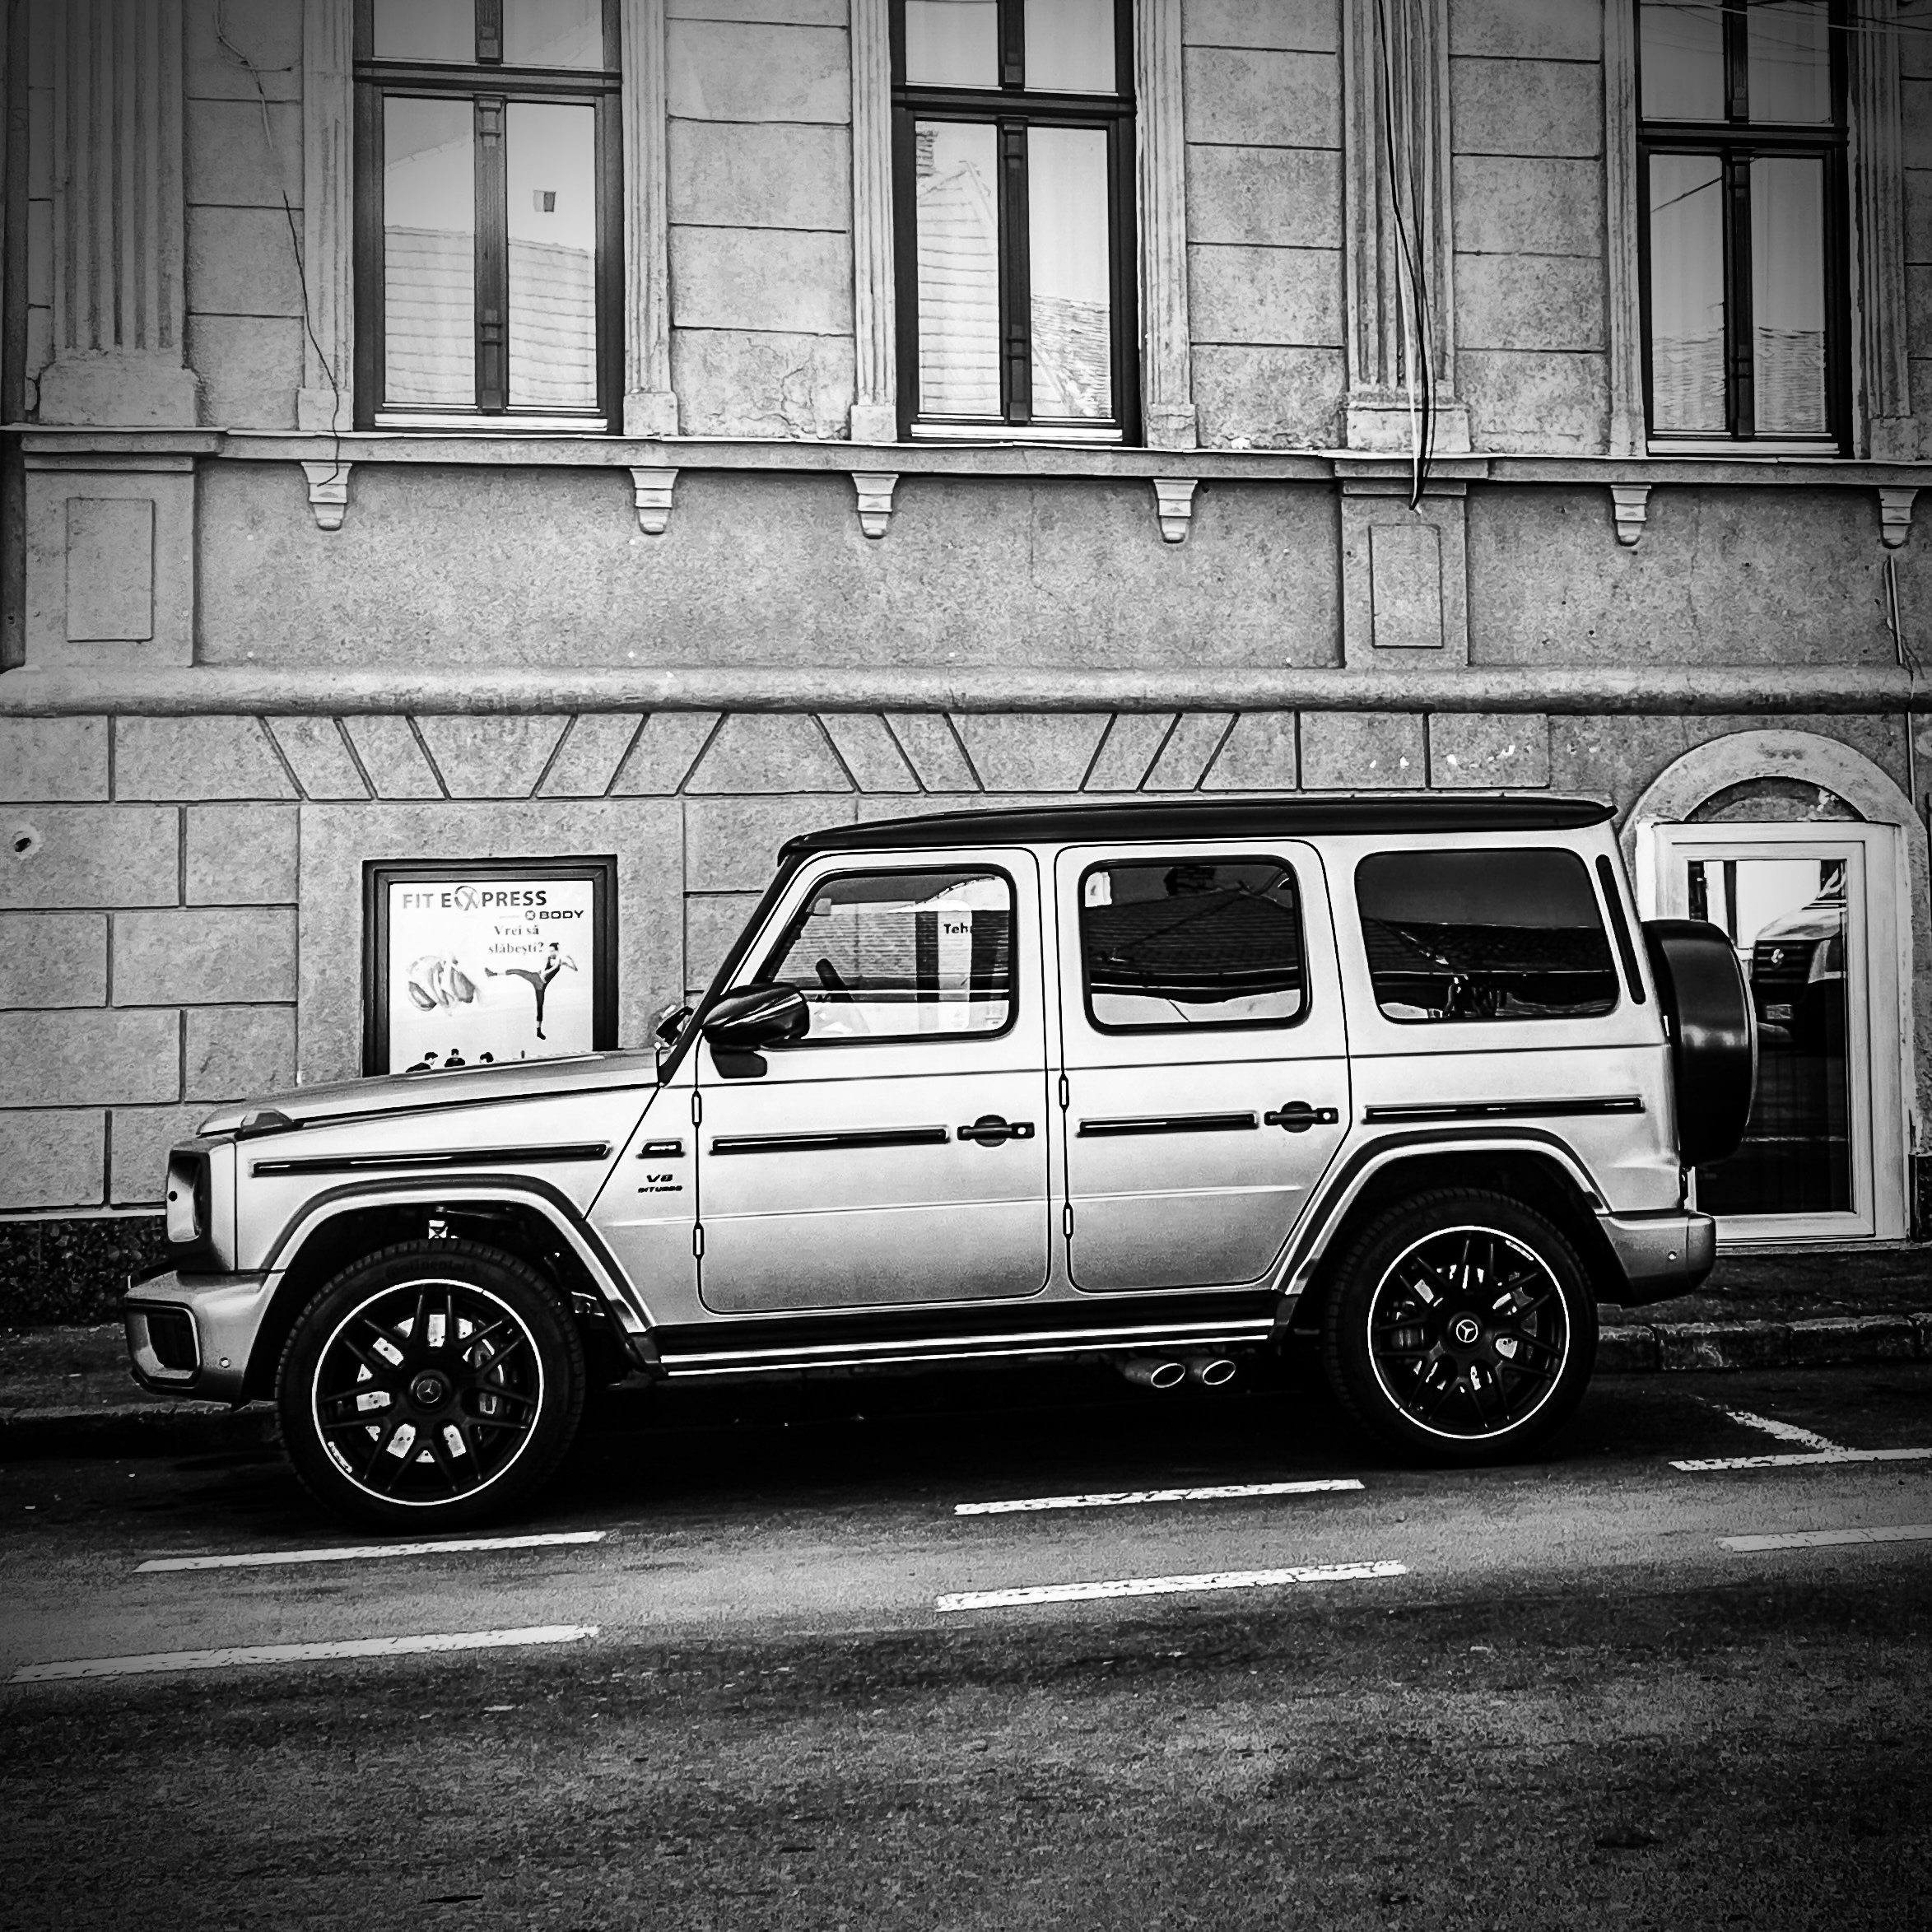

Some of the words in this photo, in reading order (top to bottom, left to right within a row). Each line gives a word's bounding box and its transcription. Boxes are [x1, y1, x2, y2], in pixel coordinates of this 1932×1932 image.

[403, 893, 434, 909] FIT
[494, 925, 522, 935] Vrei
[943, 922, 972, 933] Teh
